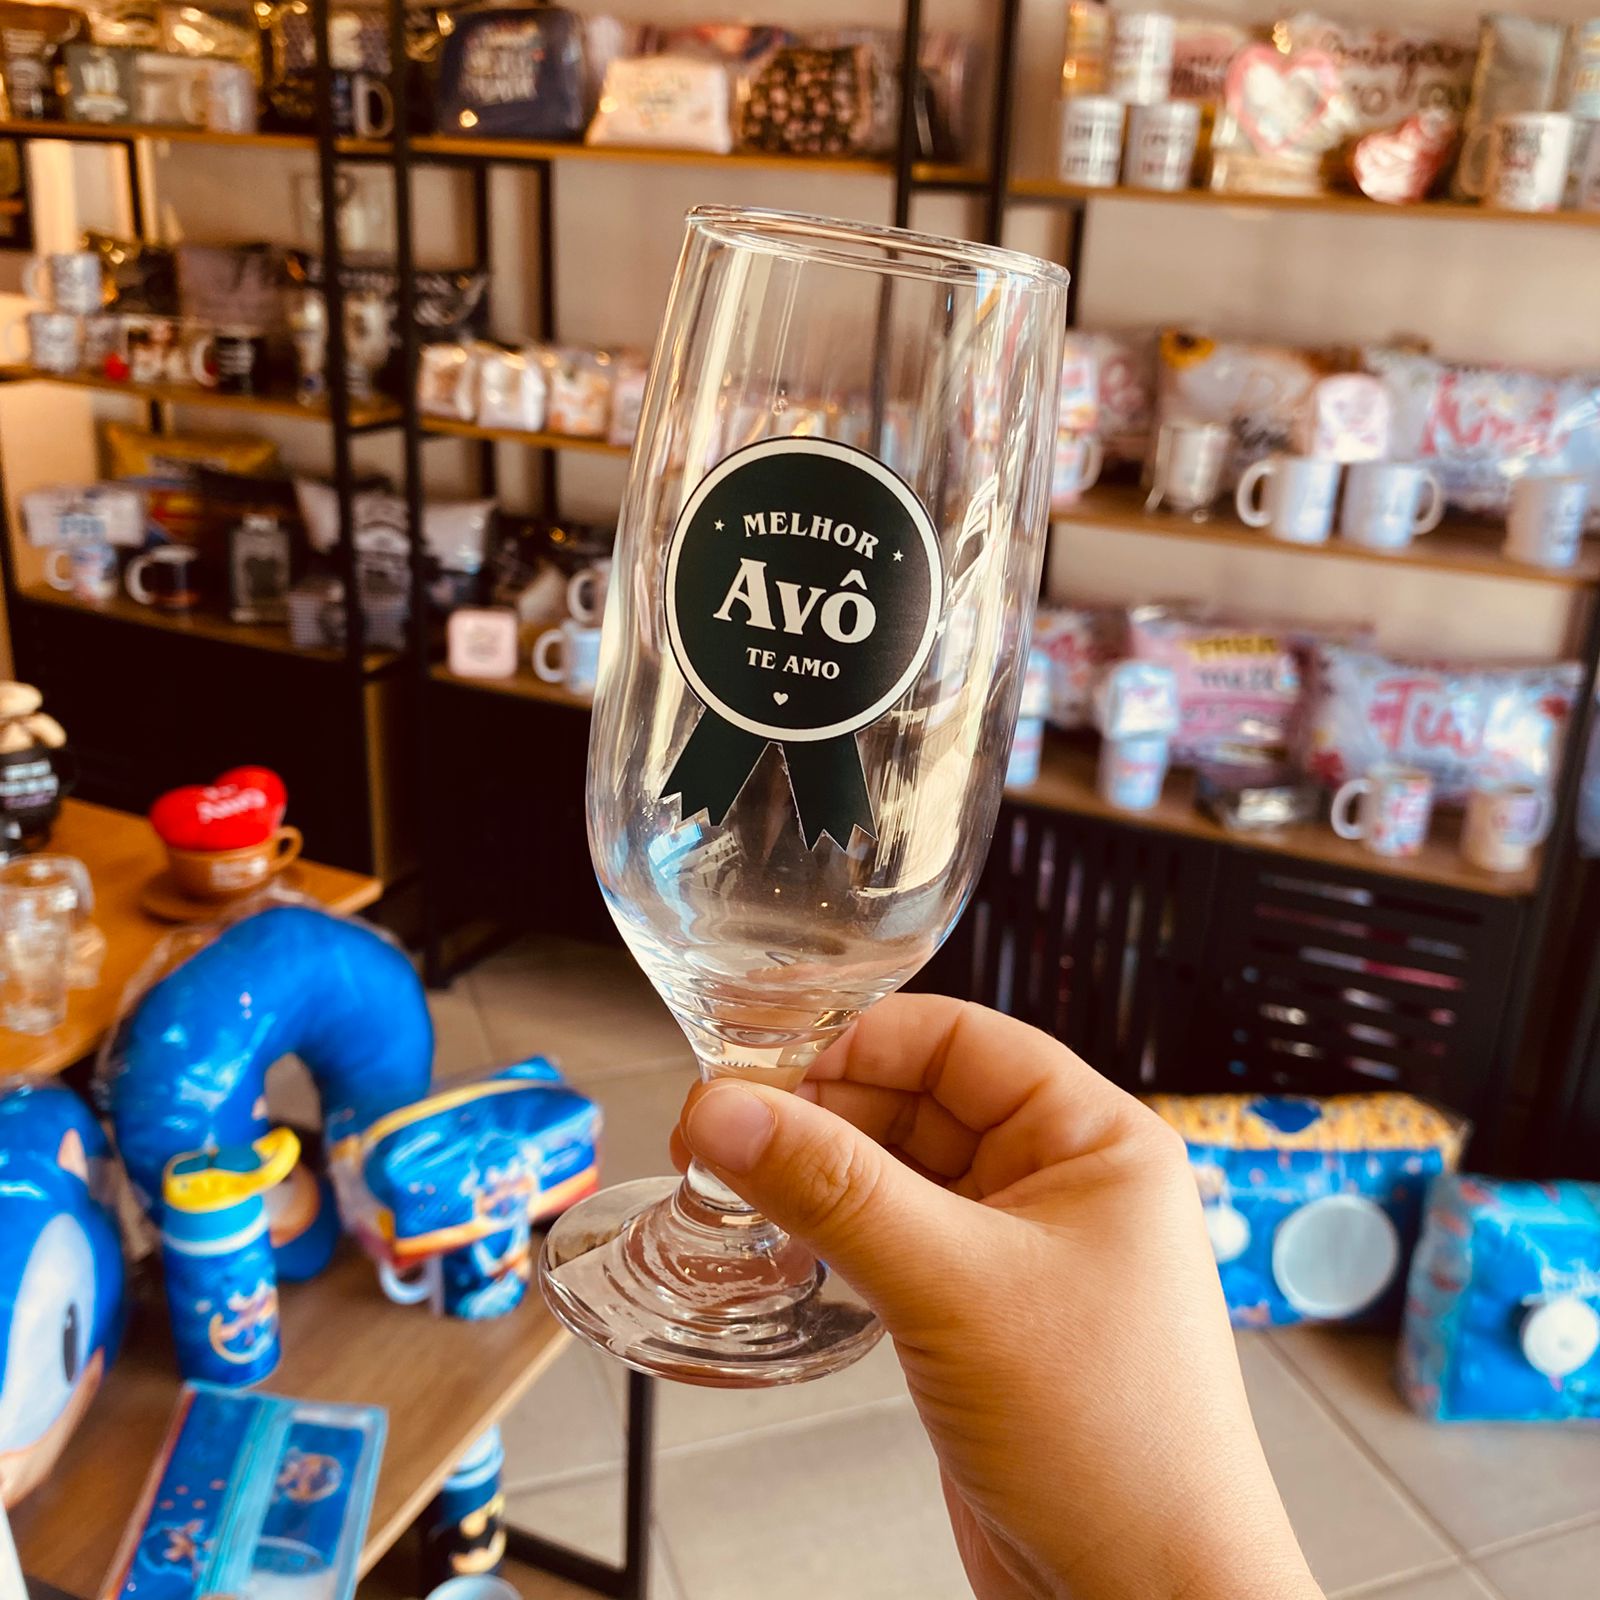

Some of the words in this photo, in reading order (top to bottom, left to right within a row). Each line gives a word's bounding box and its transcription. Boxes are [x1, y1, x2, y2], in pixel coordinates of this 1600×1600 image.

[743, 511, 880, 560] MELHOR
[713, 558, 876, 644] Avô
[746, 647, 777, 670] TE
[782, 655, 841, 680] AMO
